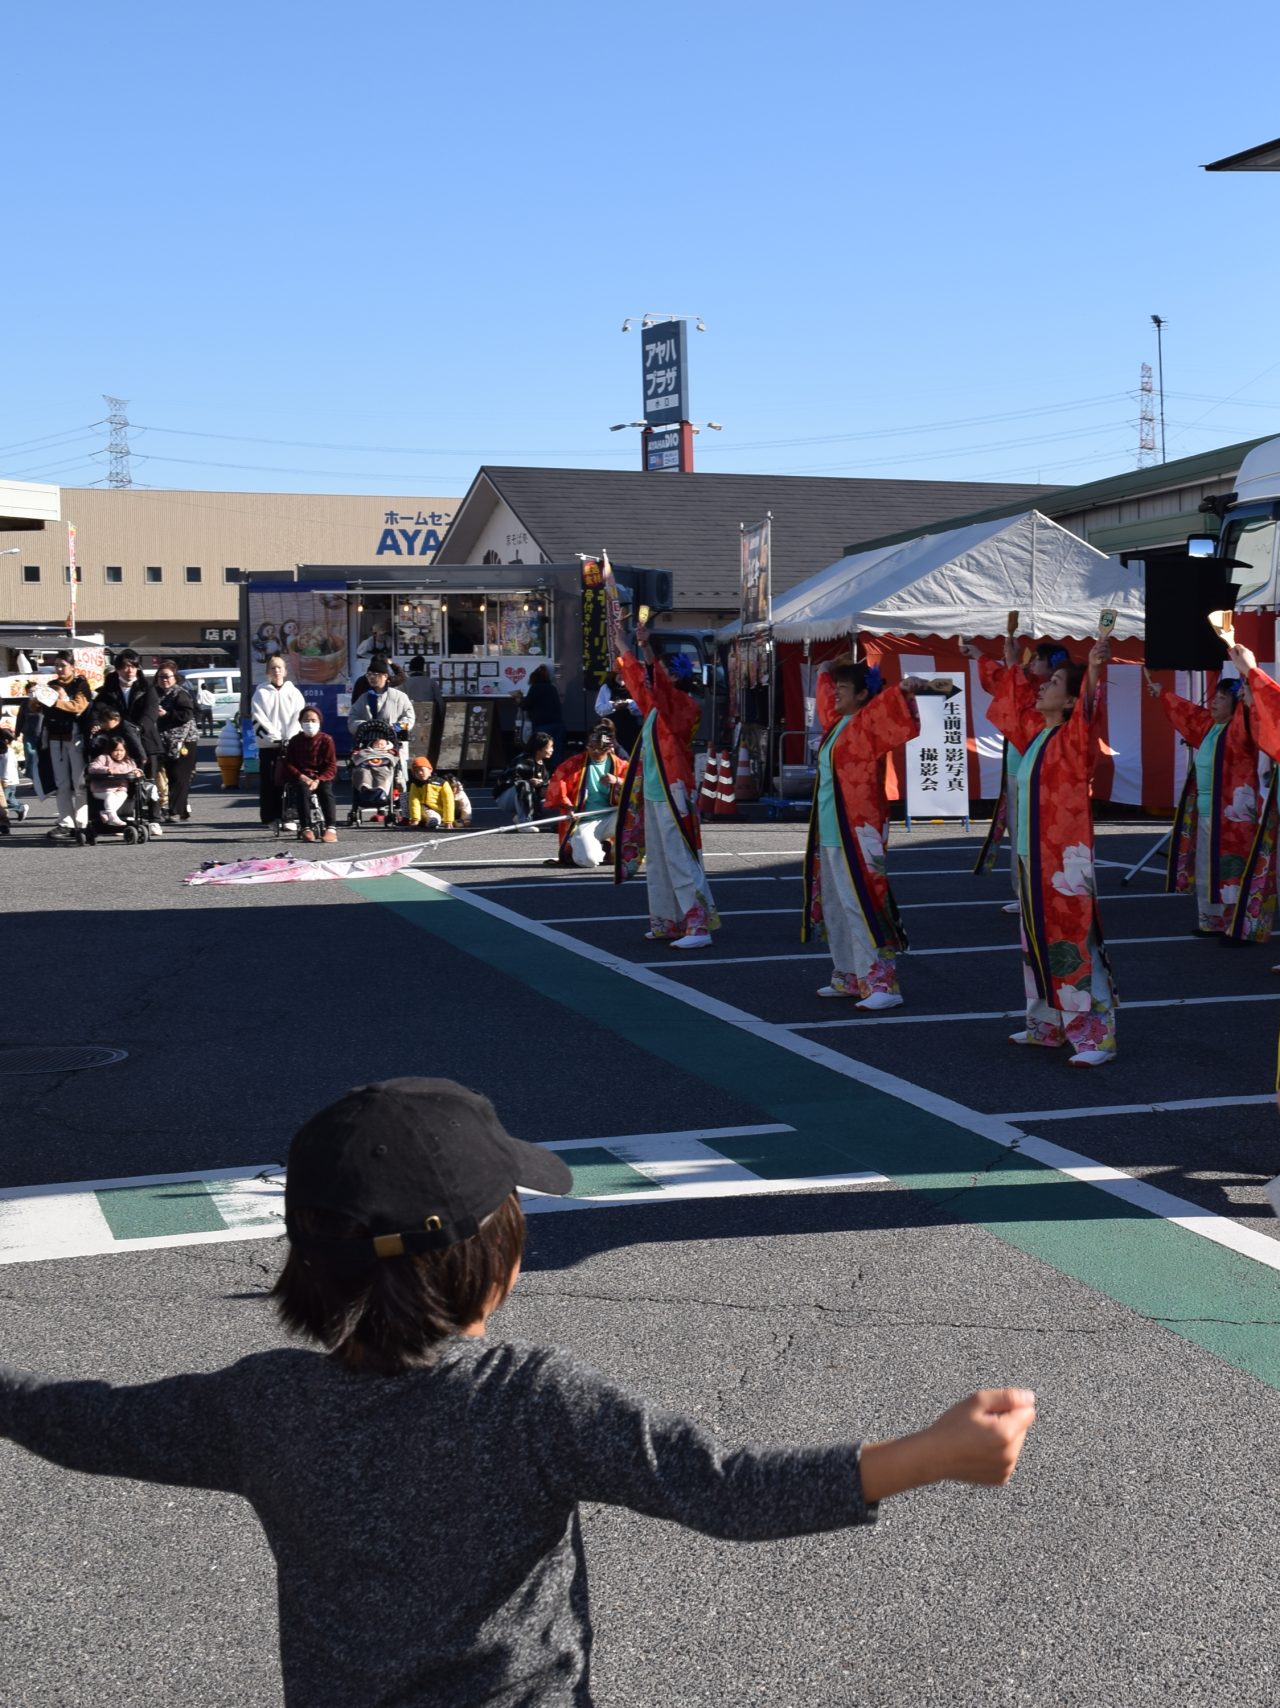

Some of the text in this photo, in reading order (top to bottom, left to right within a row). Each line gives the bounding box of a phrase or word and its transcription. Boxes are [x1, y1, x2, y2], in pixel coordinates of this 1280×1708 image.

[645, 338, 677, 367] アヤハ
[646, 366, 677, 396] プラザ
[205, 629, 236, 641] 店内
[943, 702, 965, 792] 生前遺影写真
[920, 748, 939, 792] 撮影会
